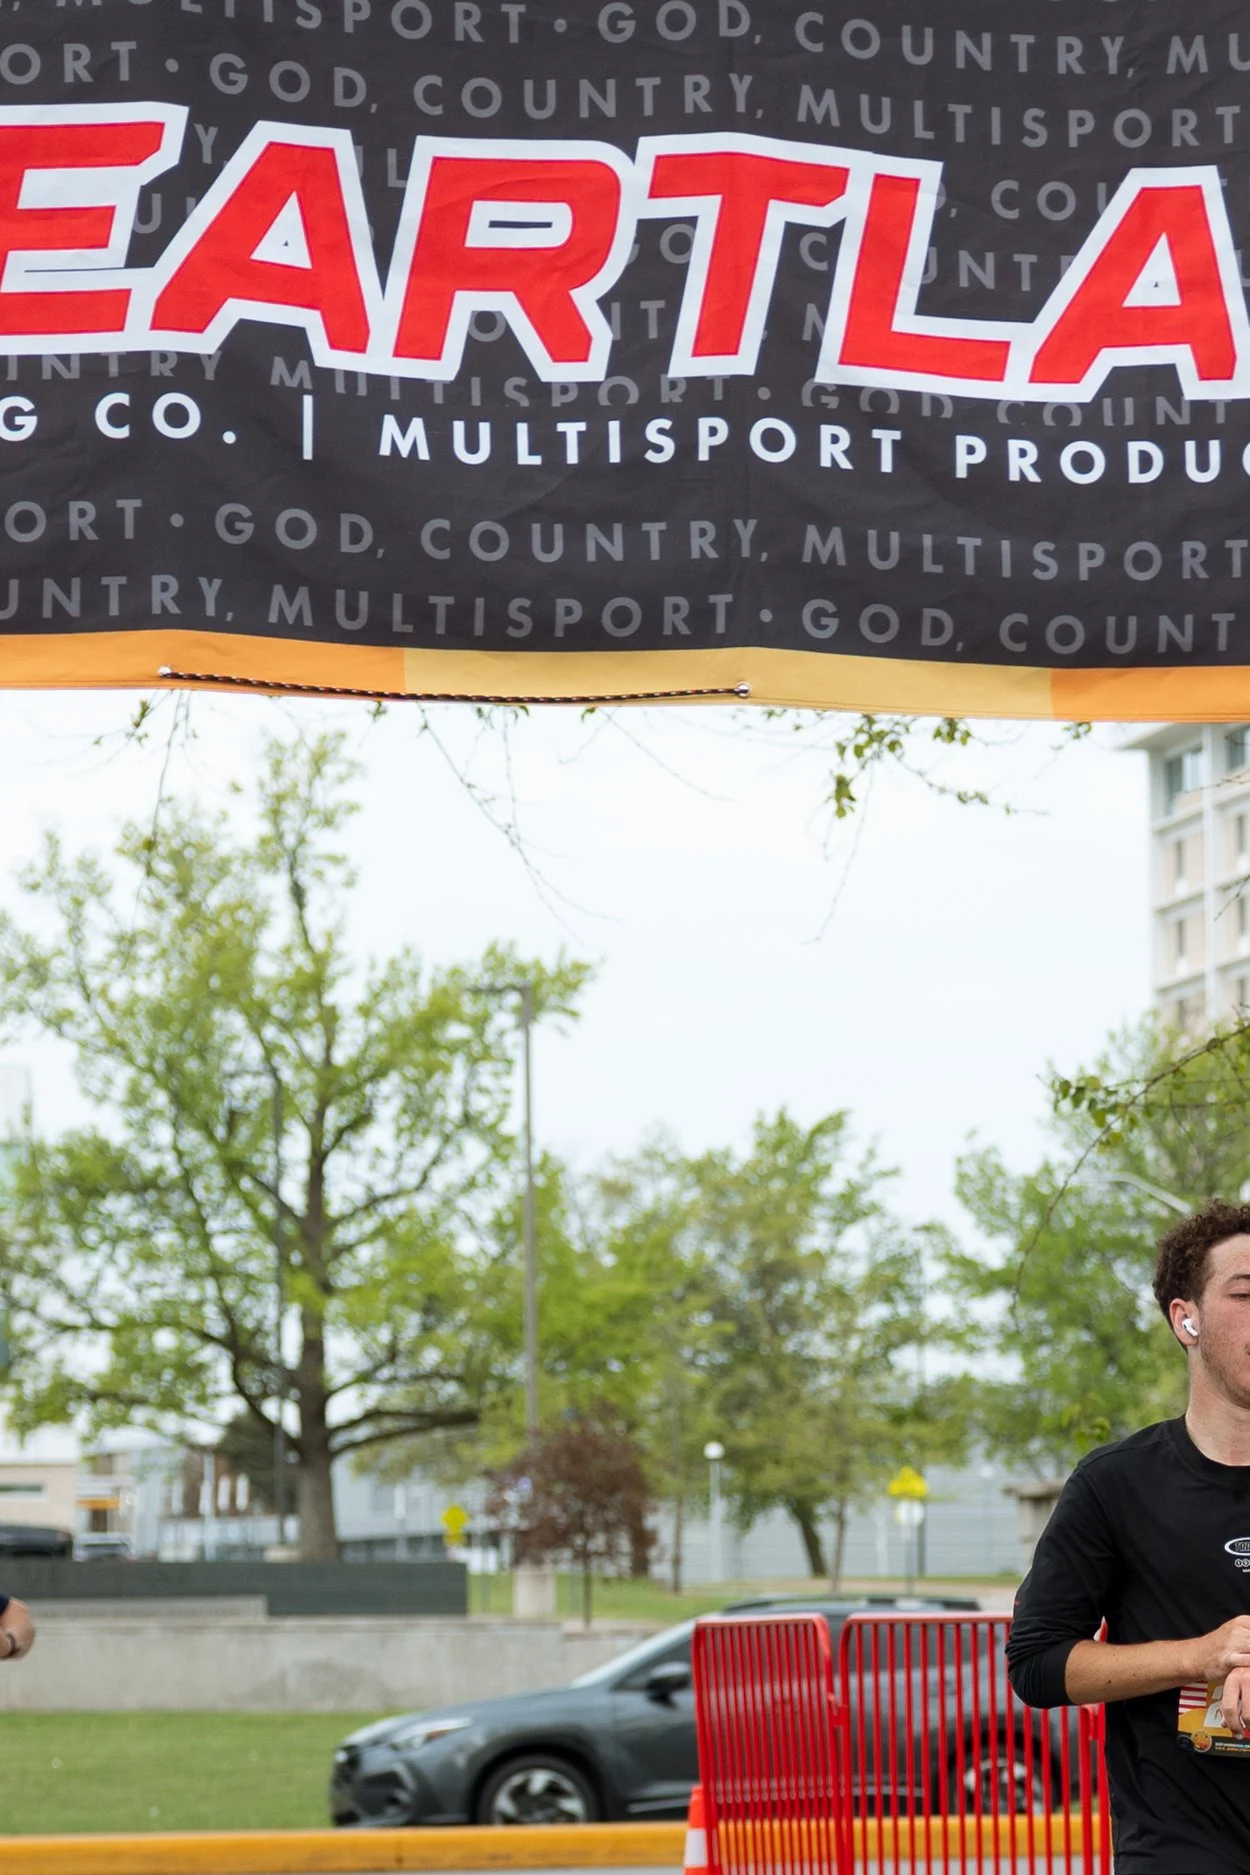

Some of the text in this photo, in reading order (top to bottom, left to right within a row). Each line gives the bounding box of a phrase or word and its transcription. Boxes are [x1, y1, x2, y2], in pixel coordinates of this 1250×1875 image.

[57, 0, 525, 43] ISPORT
[597, 0, 761, 45] GOD,
[794, 11, 1134, 78] COUNTRY,
[209, 52, 378, 114] GOD,
[413, 73, 763, 120] COUNTRY,
[798, 85, 1240, 148] MULTISPORT
[95, 392, 237, 444] CO.
[379, 413, 902, 473] MULTISPORT
[215, 502, 384, 558] GOD,
[421, 518, 768, 563] COUNTRY,
[802, 524, 1249, 581] MULTISPORT
[267, 584, 734, 638] MULTISPORT
[801, 599, 965, 652] GOD,
